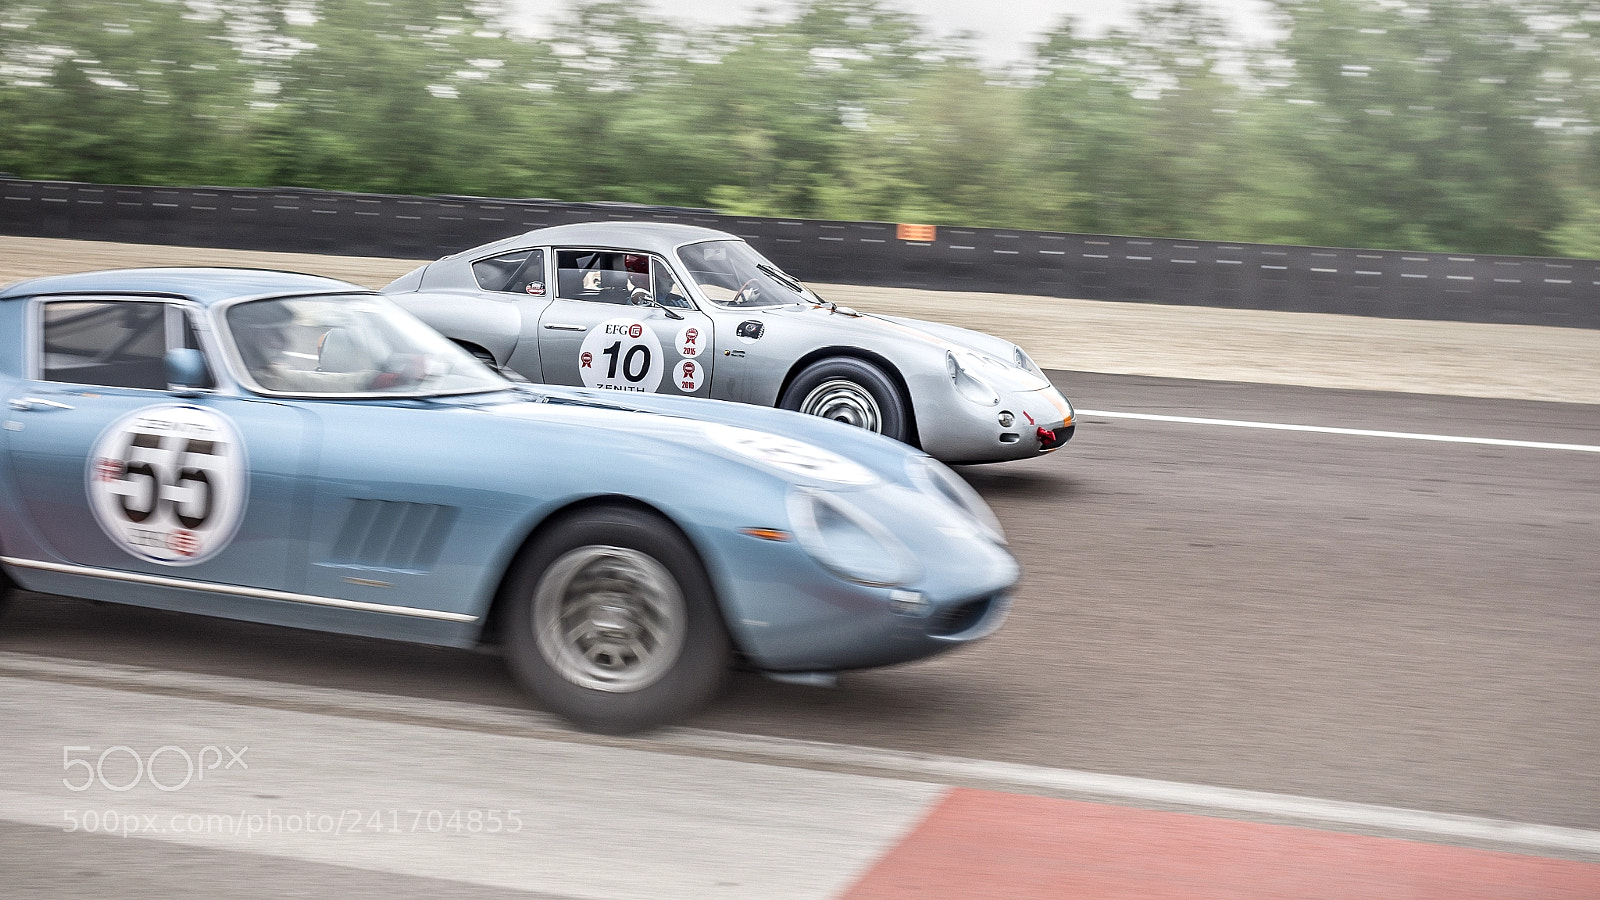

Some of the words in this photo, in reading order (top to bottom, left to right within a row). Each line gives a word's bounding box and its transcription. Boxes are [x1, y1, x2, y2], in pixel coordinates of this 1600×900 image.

[605, 324, 628, 336] EFG
[603, 341, 651, 382] 10
[112, 431, 222, 530] 55
